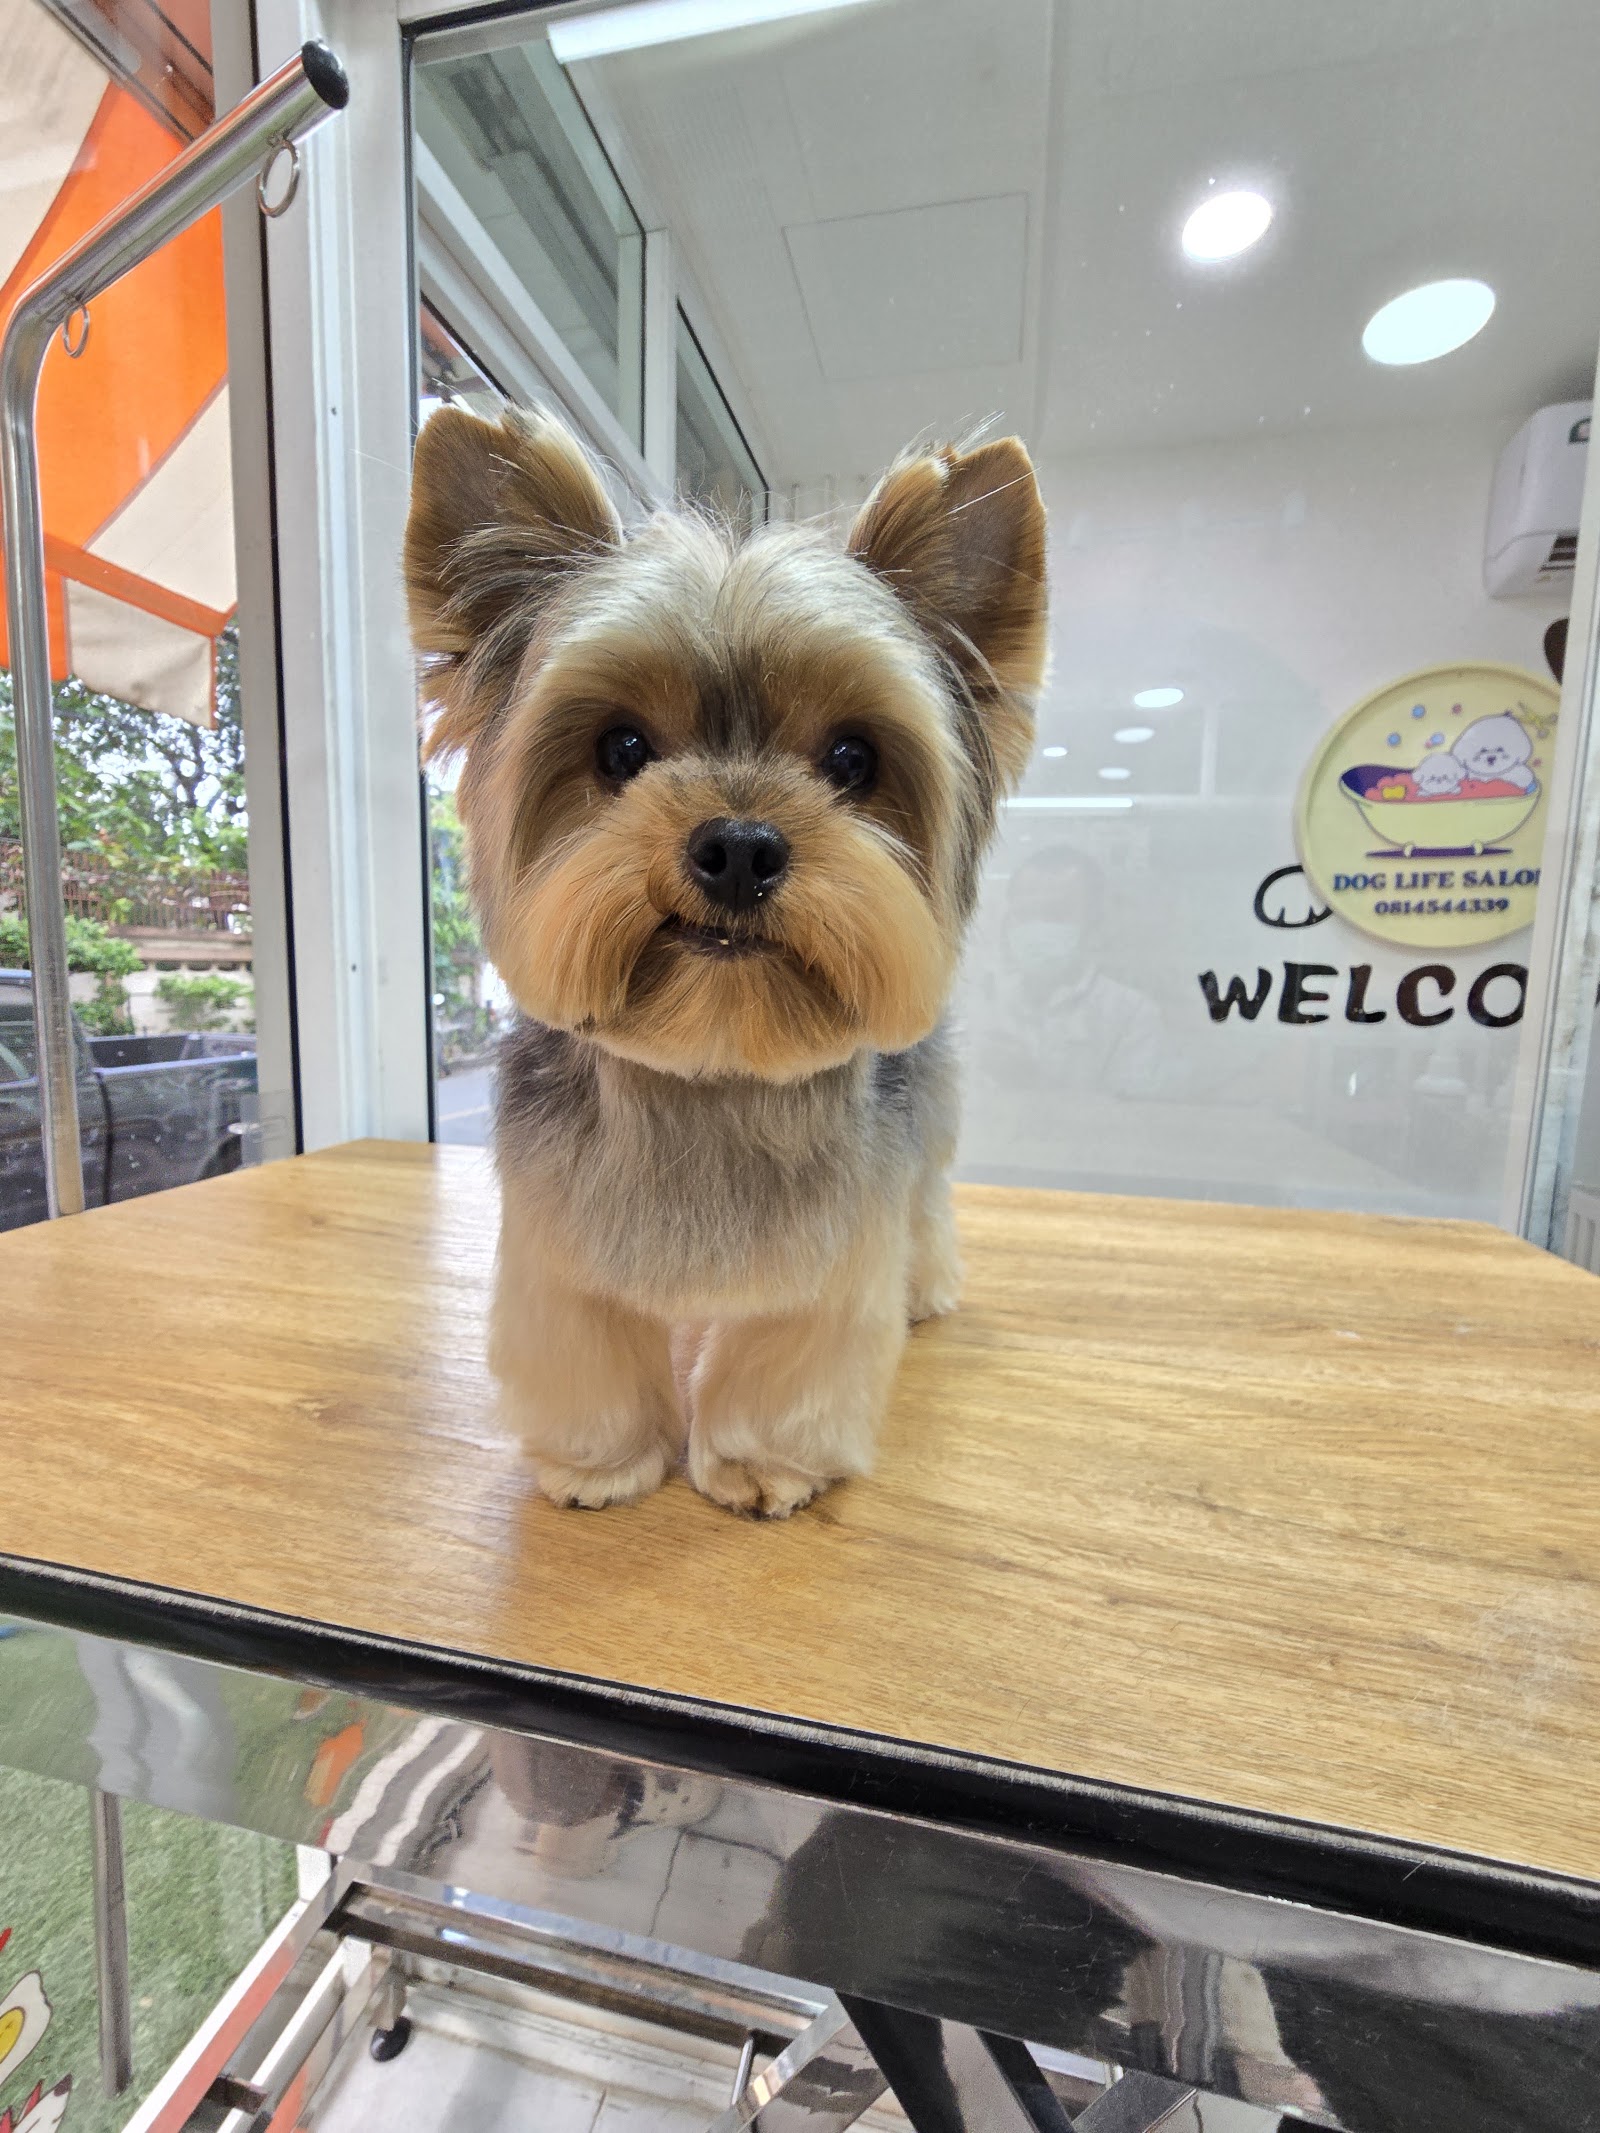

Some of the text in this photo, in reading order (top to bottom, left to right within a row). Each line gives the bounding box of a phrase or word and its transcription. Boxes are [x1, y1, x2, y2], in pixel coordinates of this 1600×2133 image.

[1334, 873, 1386, 890] DOG
[1395, 870, 1455, 889] LIFE
[1198, 961, 1529, 1028] WELCO
